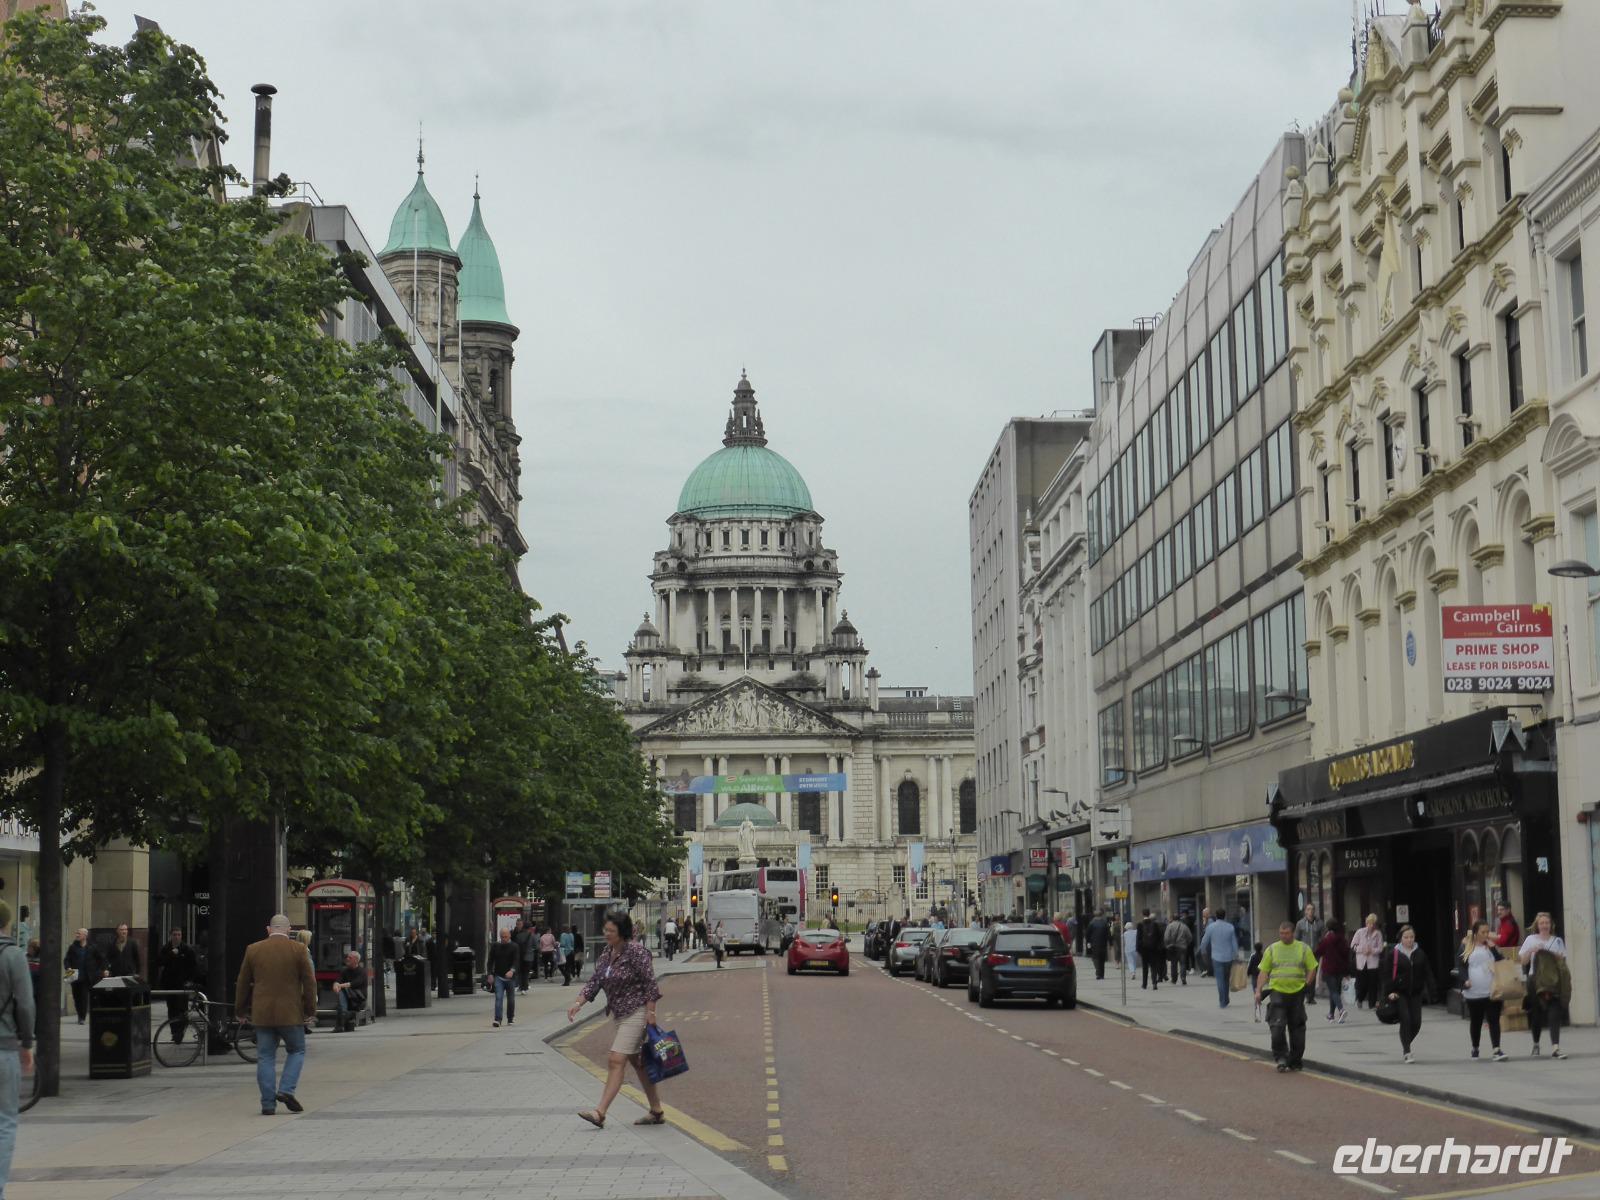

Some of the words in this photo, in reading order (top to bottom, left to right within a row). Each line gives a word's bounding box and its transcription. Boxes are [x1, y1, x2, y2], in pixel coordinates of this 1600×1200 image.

[1453, 608, 1520, 624] Campbell
[1496, 621, 1541, 634] Cairns
[1455, 643, 1498, 655] PRIME
[1502, 643, 1540, 655] SHOP
[1446, 661, 1476, 671] LEASE
[1480, 661, 1498, 670] FOR
[1502, 660, 1550, 670] DISPOSAL
[1447, 677, 1473, 691] 028
[1478, 676, 1512, 690] 9024
[1517, 676, 1552, 690] 9024
